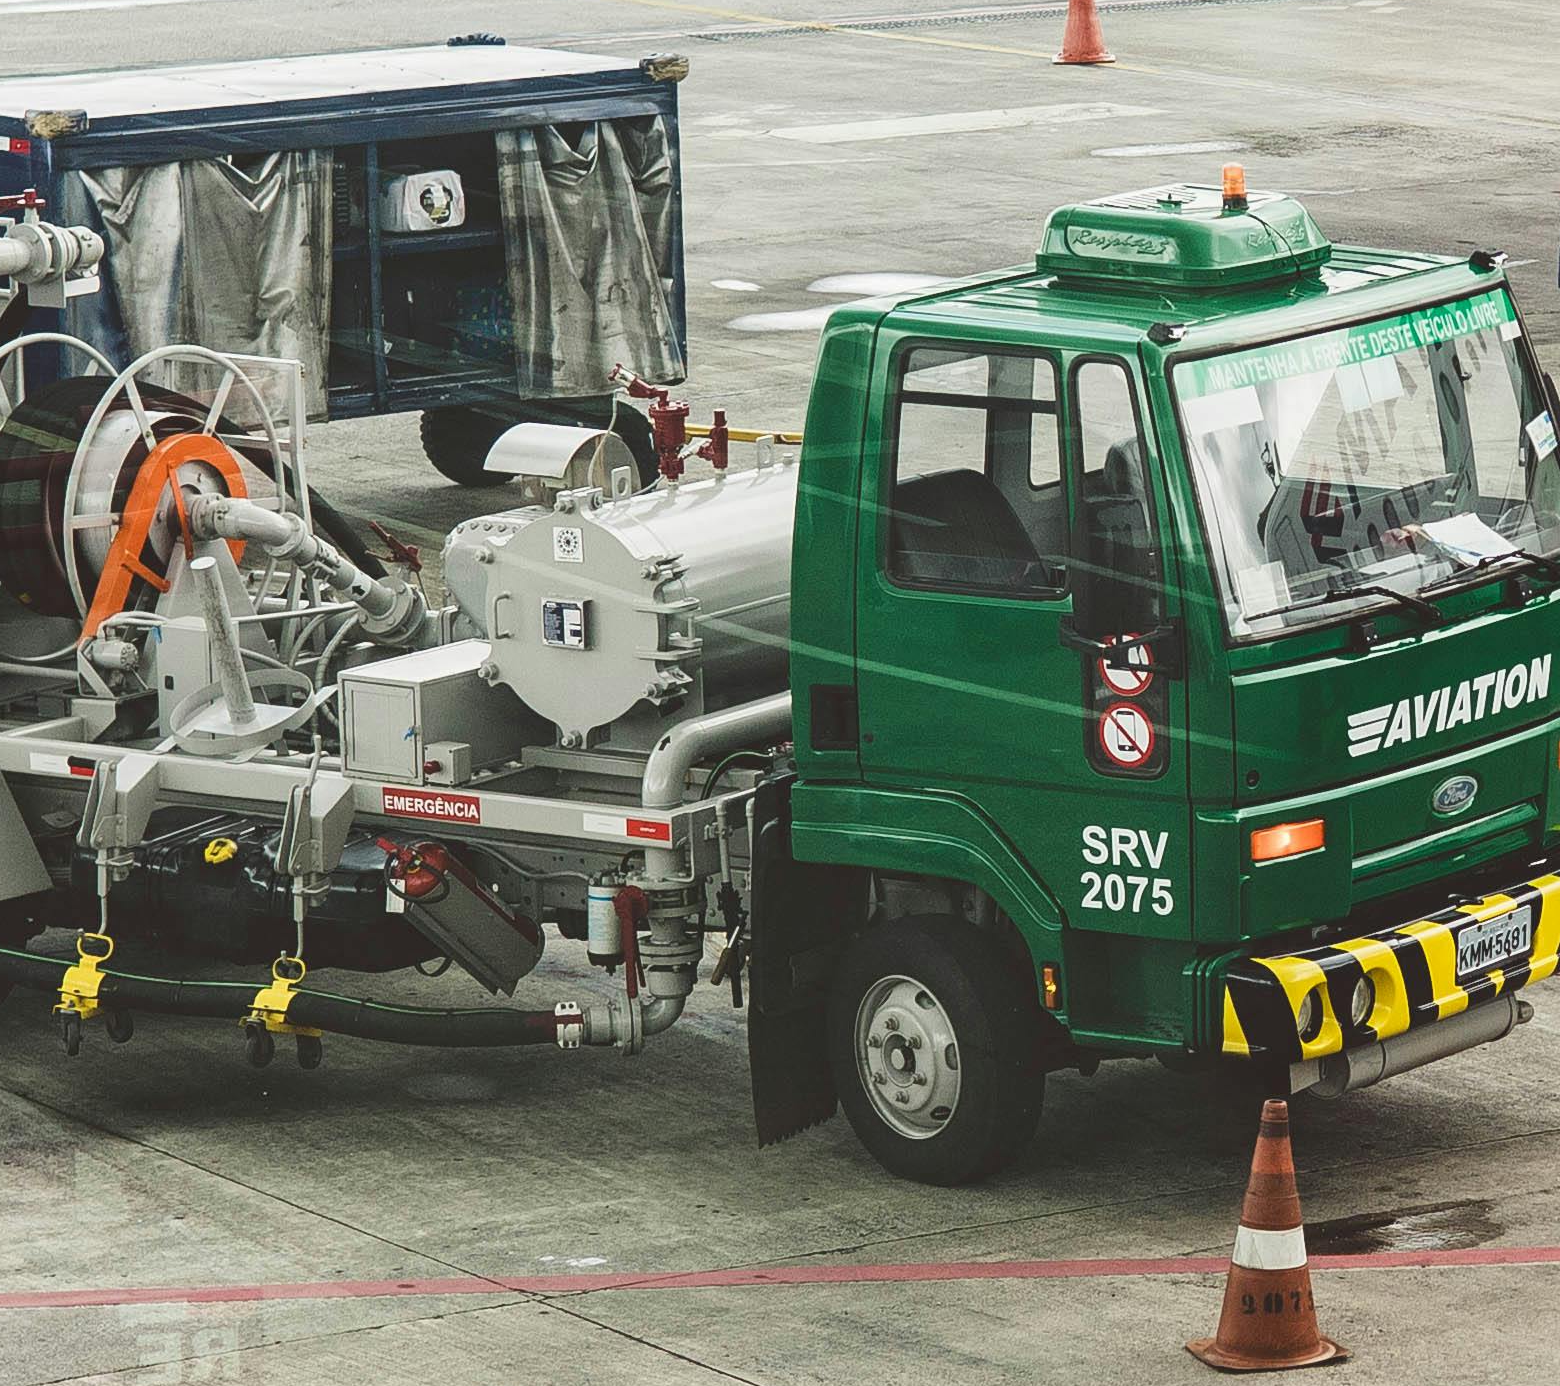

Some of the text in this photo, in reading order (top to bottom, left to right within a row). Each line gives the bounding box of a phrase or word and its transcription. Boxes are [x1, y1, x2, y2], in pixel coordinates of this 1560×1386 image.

[1207, 300, 1501, 390] MANTENHA A FRENTE DESTE VEÍCULO LIVRE
[1383, 653, 1552, 749] AVIATION
[384, 795, 480, 819] EMERGÊNCIA
[1442, 783, 1471, 805] Ford
[1082, 825, 1169, 870] SRV
[1080, 871, 1174, 916] 2075
[1459, 922, 1528, 973] KMM-5681
